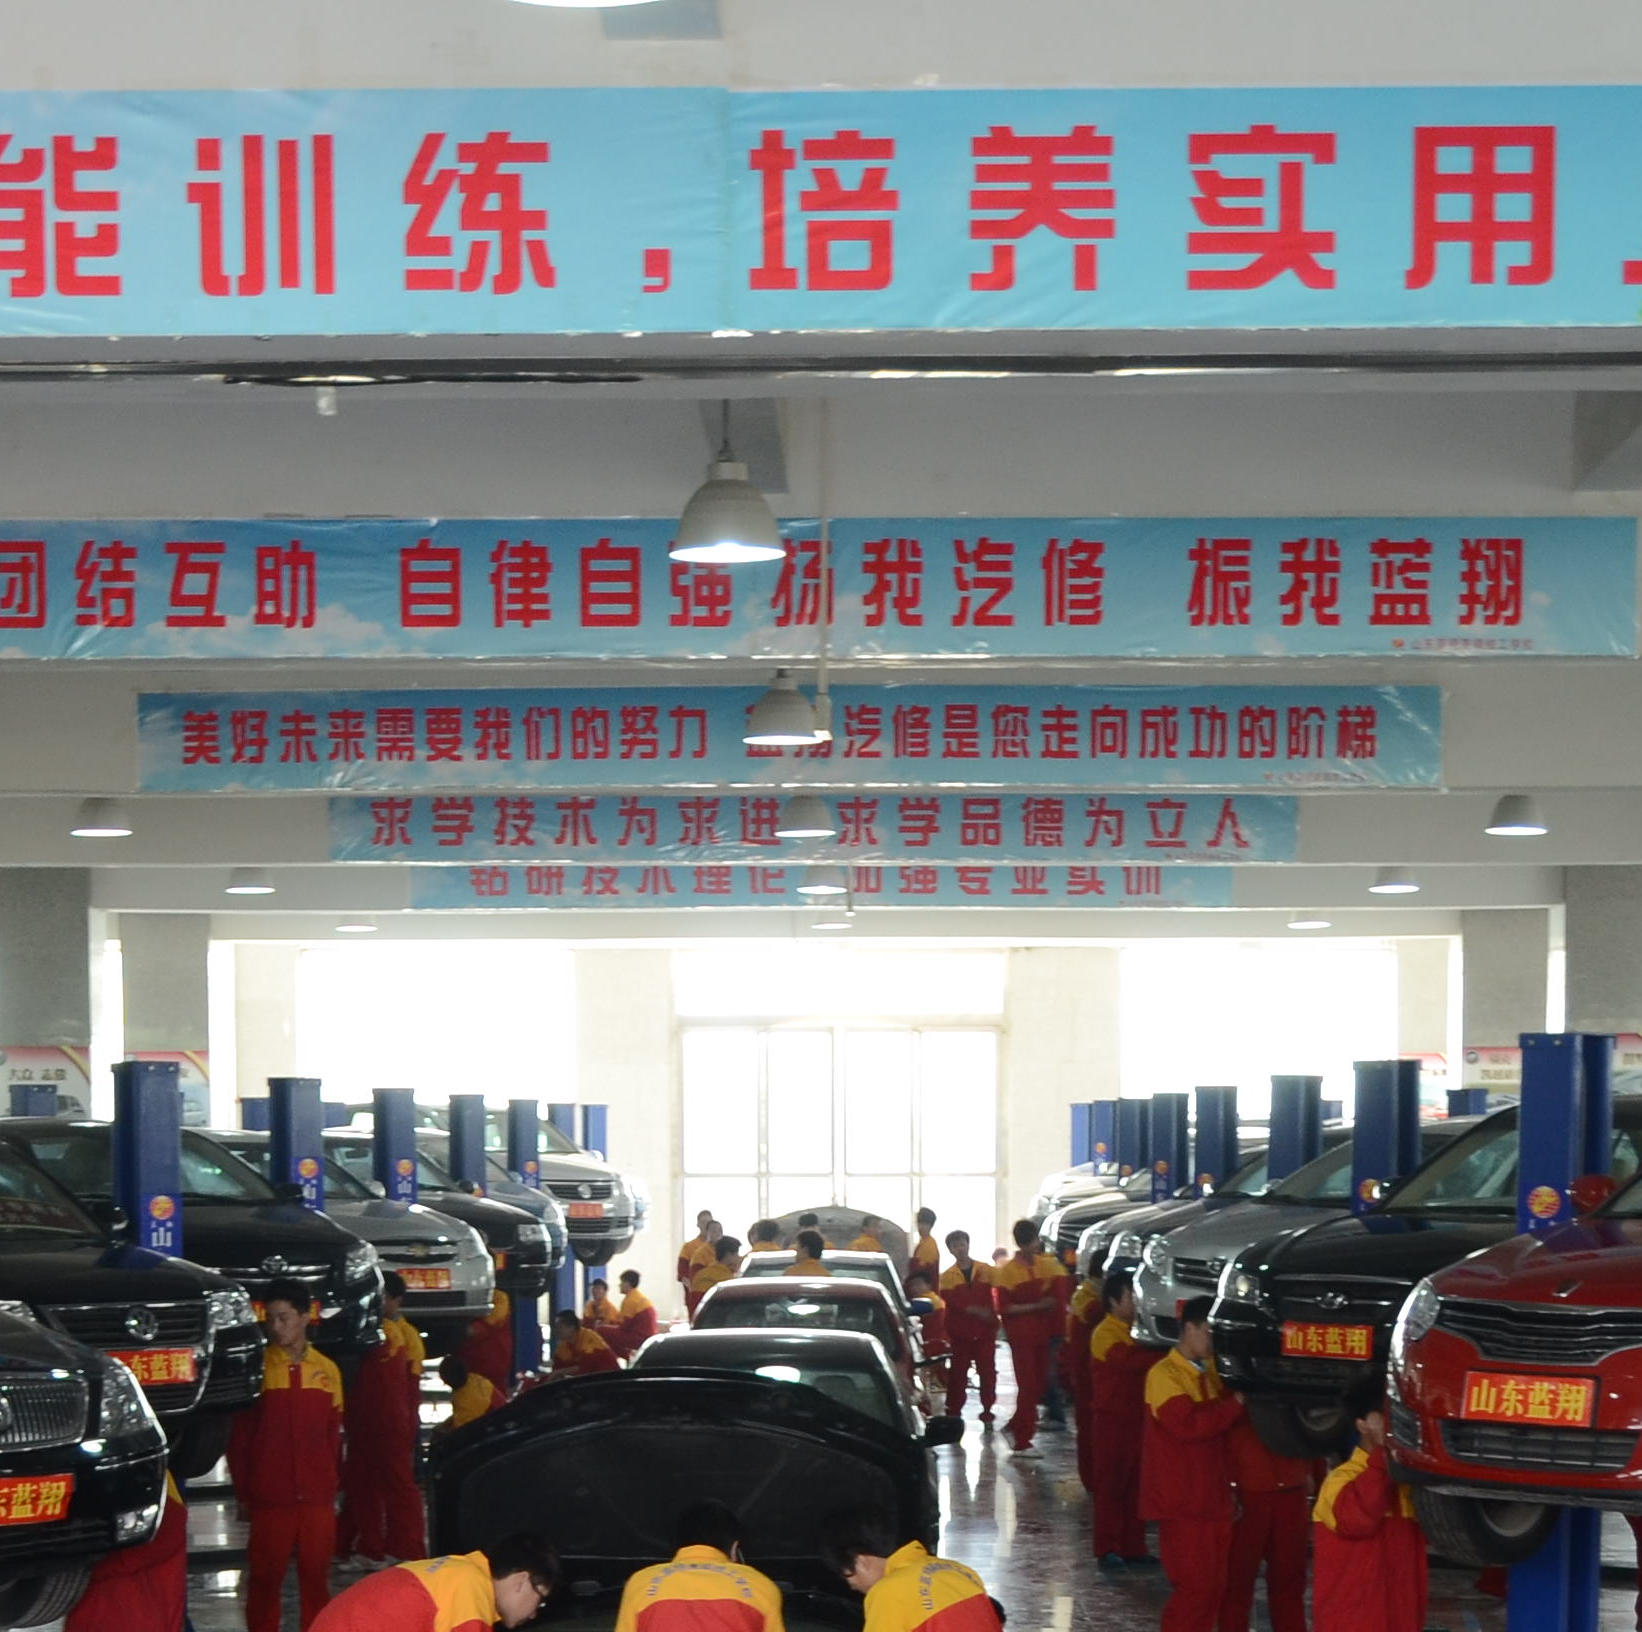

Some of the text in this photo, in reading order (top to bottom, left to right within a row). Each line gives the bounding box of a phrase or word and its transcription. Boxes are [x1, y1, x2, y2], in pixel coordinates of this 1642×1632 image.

[1187, 537, 1525, 628] 振我蓝翔
[181, 703, 1378, 765] 美好未来需要我们的努力 汽修是您走向成功的阶梯
[130, 1353, 195, 1382] 东蓝翔
[1469, 1378, 1588, 1423] 山东蓝翔
